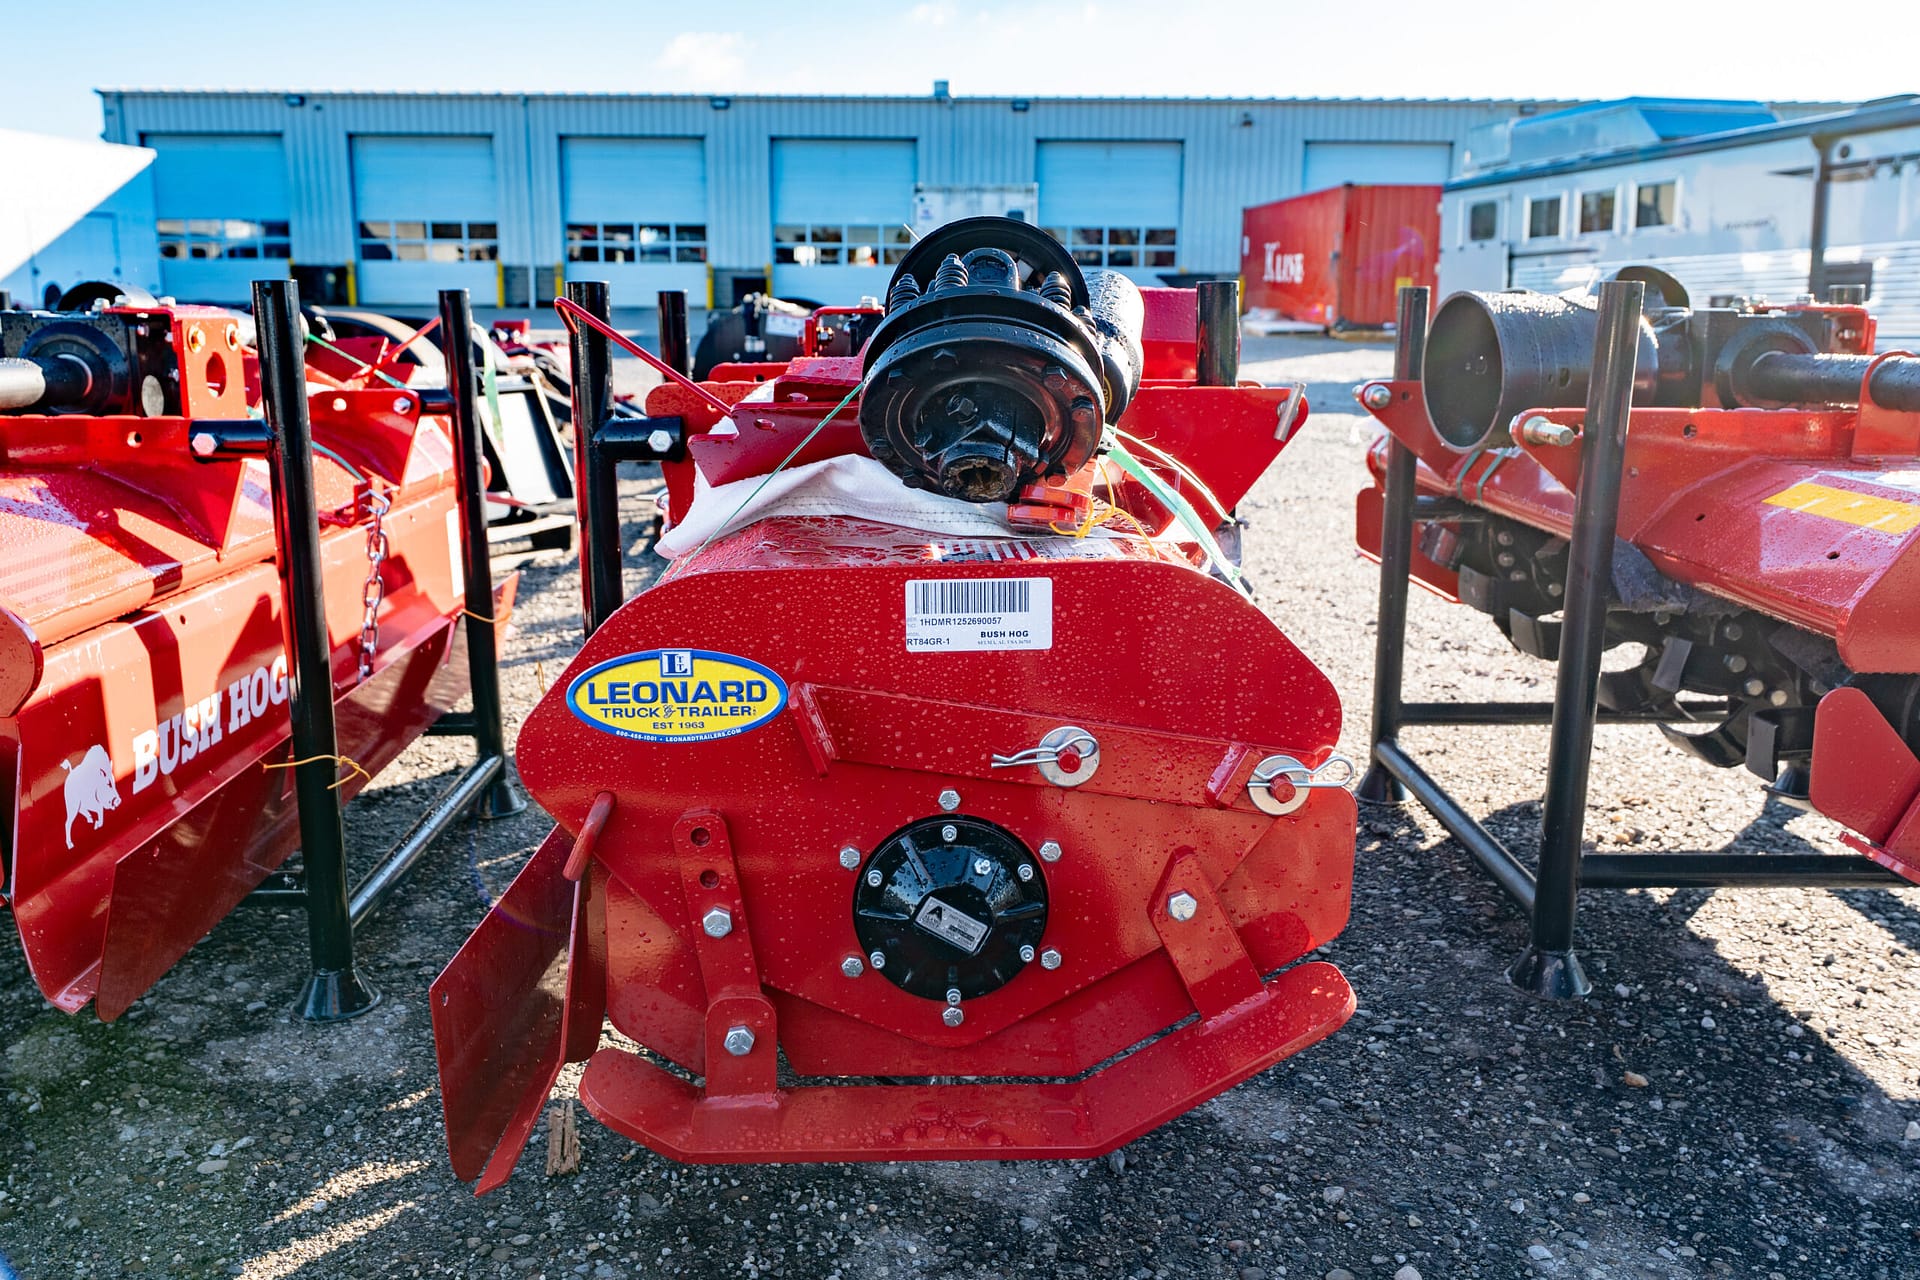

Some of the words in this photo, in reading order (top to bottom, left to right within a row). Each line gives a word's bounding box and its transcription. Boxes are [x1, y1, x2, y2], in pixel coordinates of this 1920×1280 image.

[919, 616, 1002, 627] 1HDMR1252690057
[980, 630, 1006, 638] BUSH
[1008, 630, 1029, 638] HOG
[906, 637, 951, 646] RT84GR-1
[587, 680, 767, 705] LEONARD
[600, 707, 660, 719] TRUCK
[676, 705, 752, 717] TRAILER
[132, 690, 223, 795] BUSH
[228, 654, 289, 735] HOG
[652, 721, 674, 730] EST
[678, 721, 705, 729] 1963
[665, 727, 742, 743] LEONARDTRAILERS.COM
